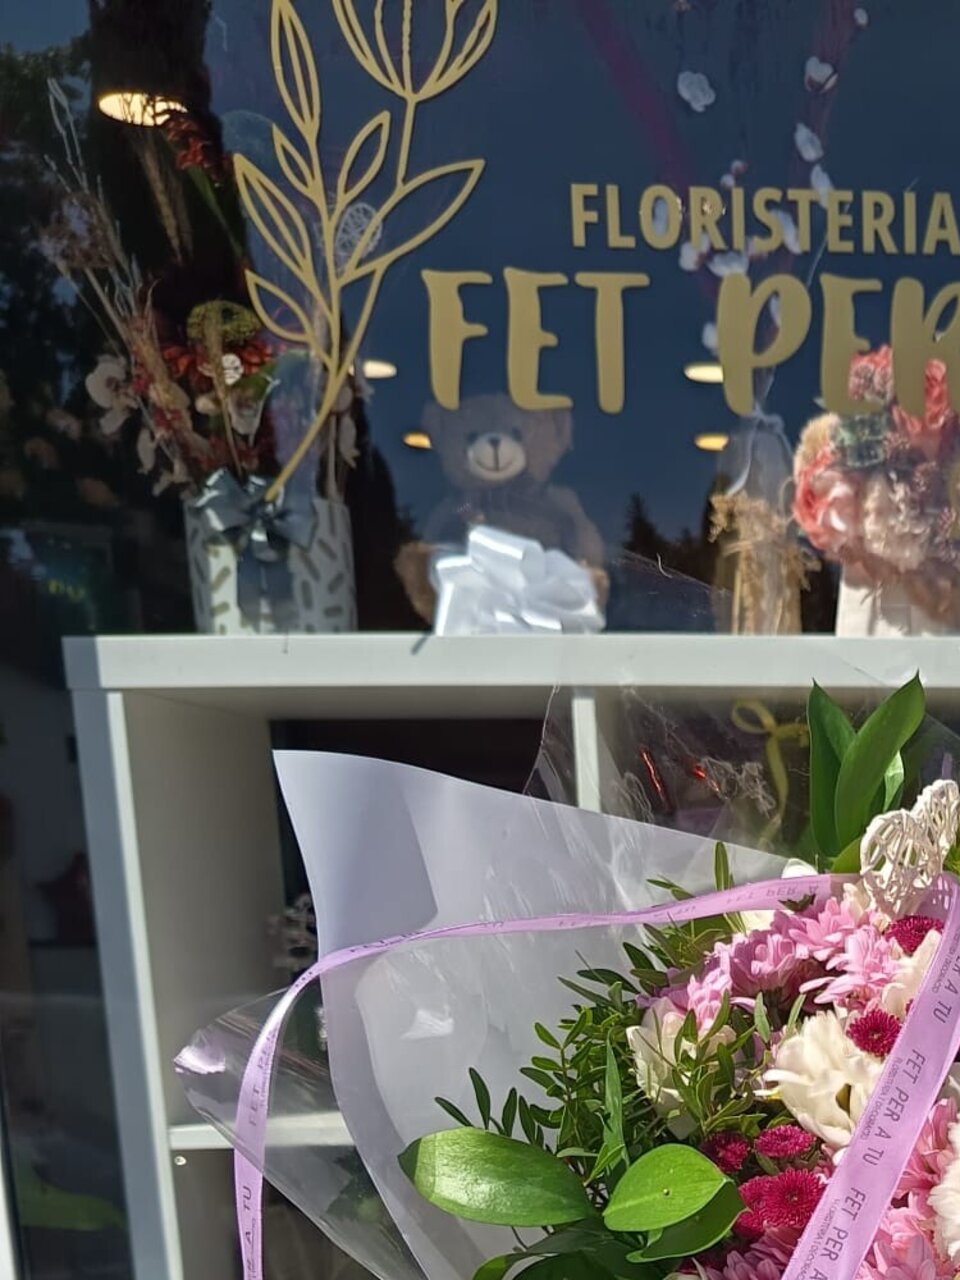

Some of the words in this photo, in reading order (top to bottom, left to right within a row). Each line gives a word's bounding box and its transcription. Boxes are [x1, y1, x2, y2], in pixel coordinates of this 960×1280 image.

[421, 268, 651, 414] FET
[944, 980, 959, 995] A
[932, 1001, 953, 1023] TU
[903, 1049, 926, 1084] FET
[884, 1087, 909, 1123] PER
[874, 1126, 892, 1139] A
[862, 1144, 884, 1166] TU
[243, 1185, 252, 1211] TU
[845, 1187, 866, 1221] FET
[820, 1226, 848, 1262] PER
